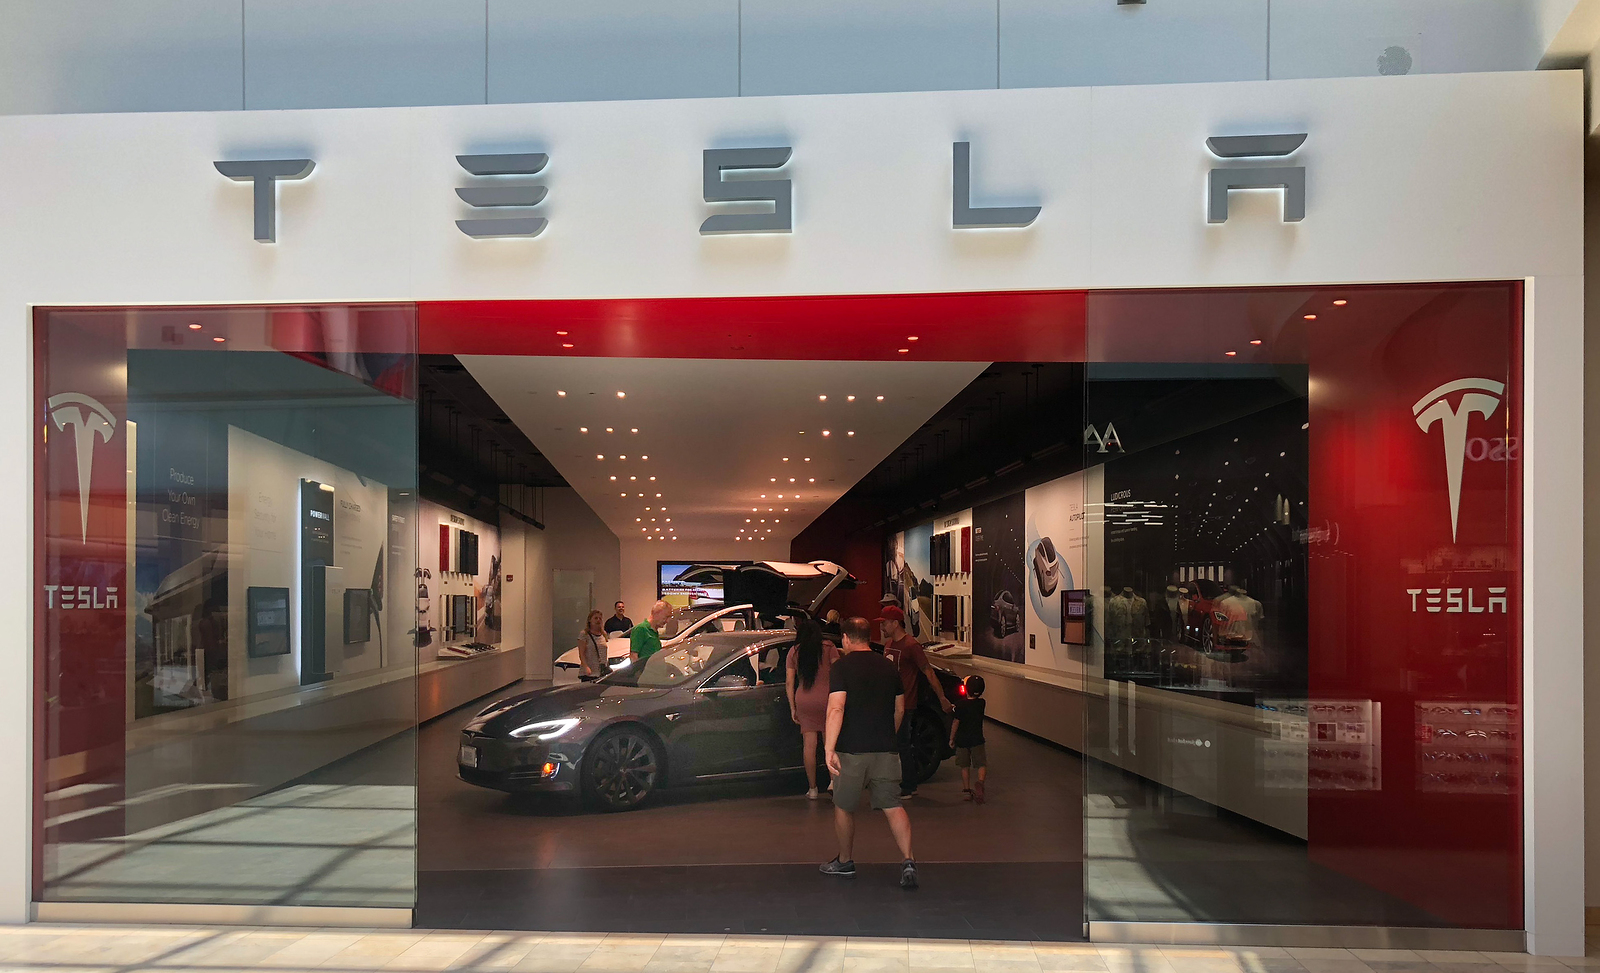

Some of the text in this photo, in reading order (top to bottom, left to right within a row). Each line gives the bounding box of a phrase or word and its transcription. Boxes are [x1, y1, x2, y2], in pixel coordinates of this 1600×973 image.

[213, 132, 1308, 244] TESLA
[170, 467, 194, 485] Produce
[167, 489, 196, 506] Your Own
[1110, 489, 1131, 501] LUDICROUS
[162, 508, 200, 529] Clean Energy
[310, 509, 330, 521] POWERWALL
[44, 585, 118, 610] TESLA
[1406, 587, 1507, 613] TESLA
